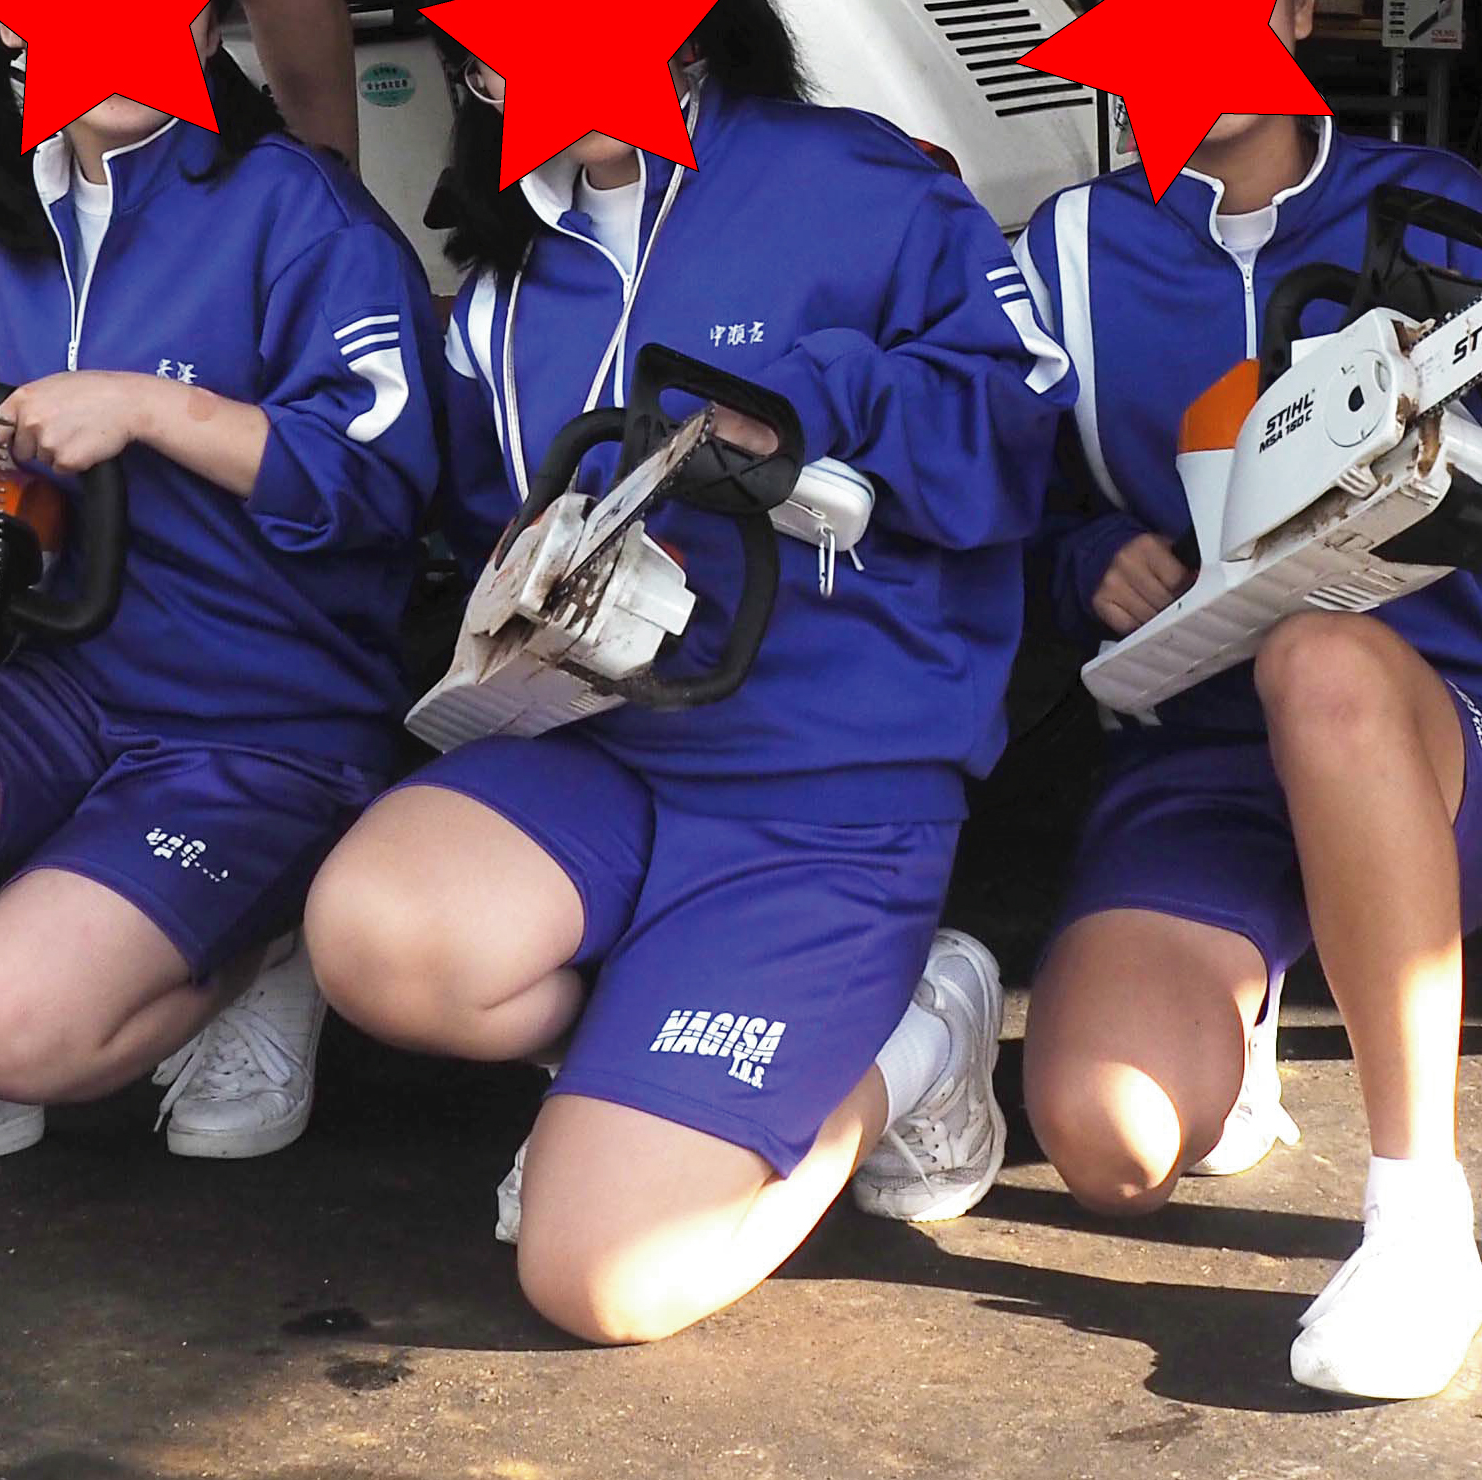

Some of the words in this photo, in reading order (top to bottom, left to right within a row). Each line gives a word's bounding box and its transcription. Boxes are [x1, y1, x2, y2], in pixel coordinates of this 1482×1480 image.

[1265, 393, 1314, 436] STIHL
[1259, 429, 1283, 454] MSA
[649, 1010, 787, 1064] NAGISA
